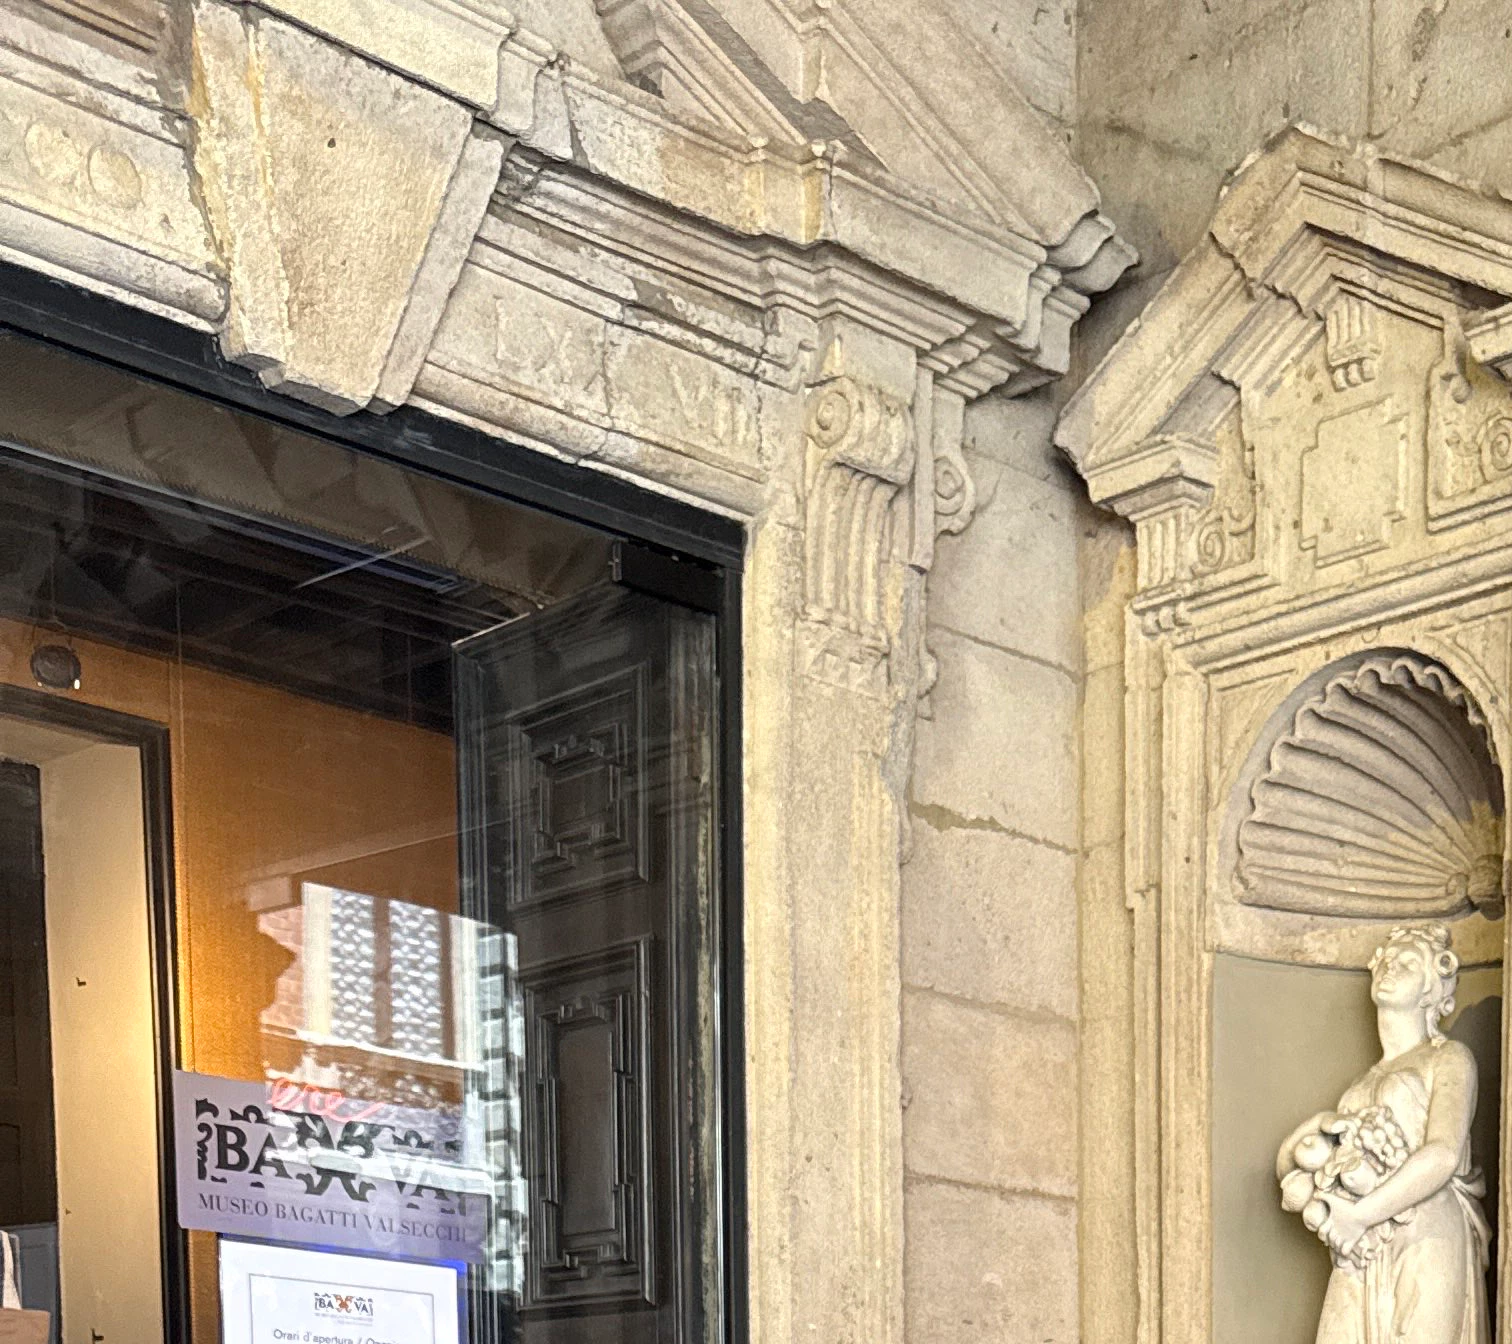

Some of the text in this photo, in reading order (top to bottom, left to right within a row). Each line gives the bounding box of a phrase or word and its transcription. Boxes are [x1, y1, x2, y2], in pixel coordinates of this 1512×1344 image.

[198, 1192, 467, 1243] MUSEO BAGATTI VALSECCHI
[273, 1328, 300, 1342] Orari
